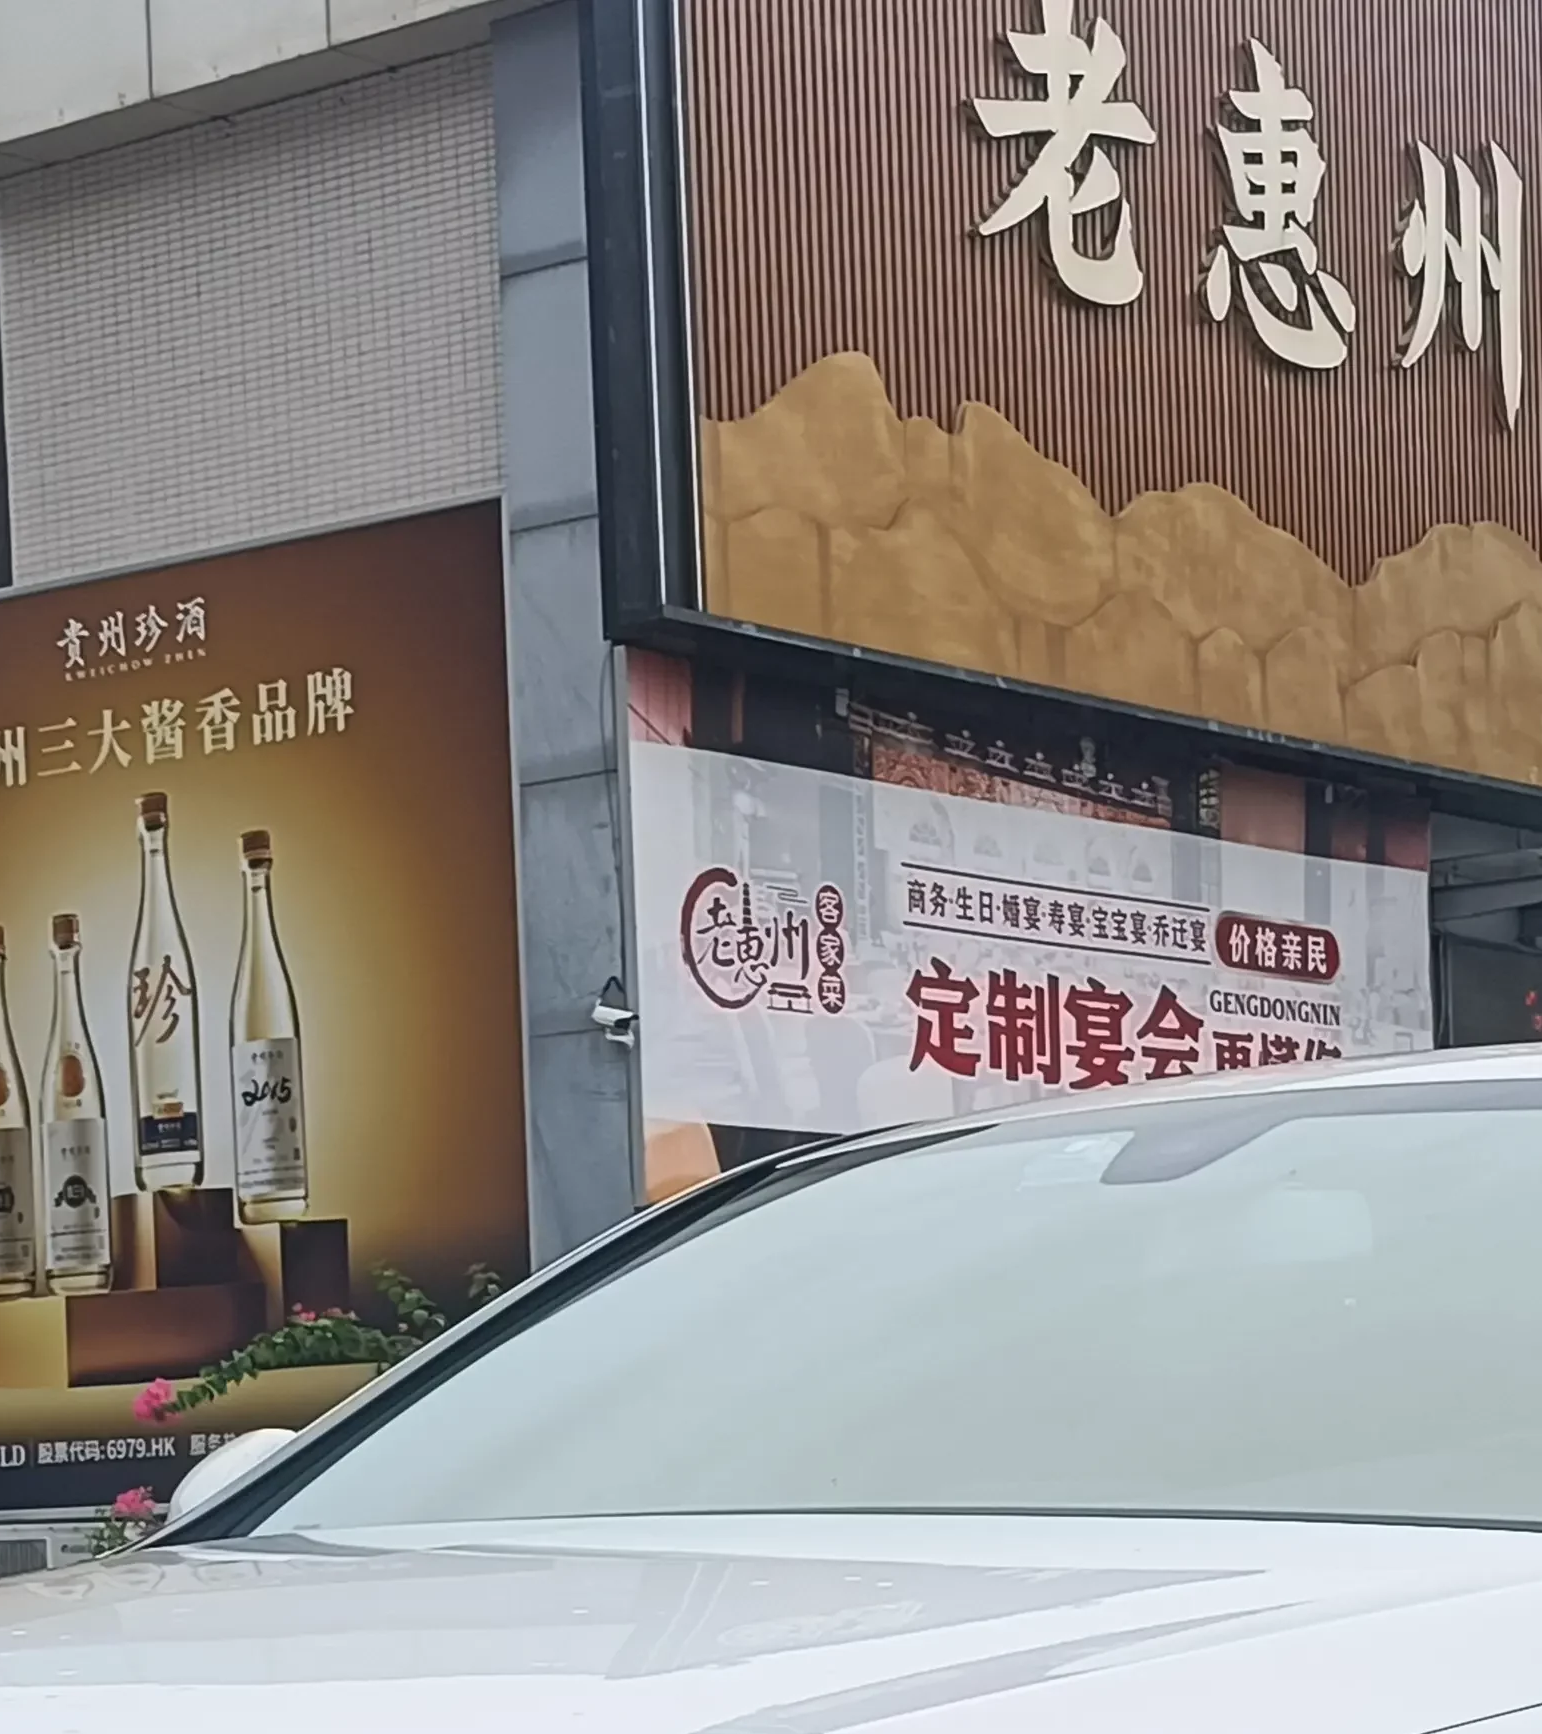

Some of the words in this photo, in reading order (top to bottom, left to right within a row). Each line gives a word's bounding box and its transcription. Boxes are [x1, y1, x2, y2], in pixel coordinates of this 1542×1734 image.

[969, 0, 1522, 430] 老惠州
[818, 890, 844, 1008] 客家菜
[1227, 922, 1329, 975] 价格亲民
[133, 954, 192, 1048] 珍
[905, 956, 1205, 1090] 定制宴会
[1209, 989, 1342, 1027] GENGDONGNIN
[241, 1075, 292, 1108] 2015
